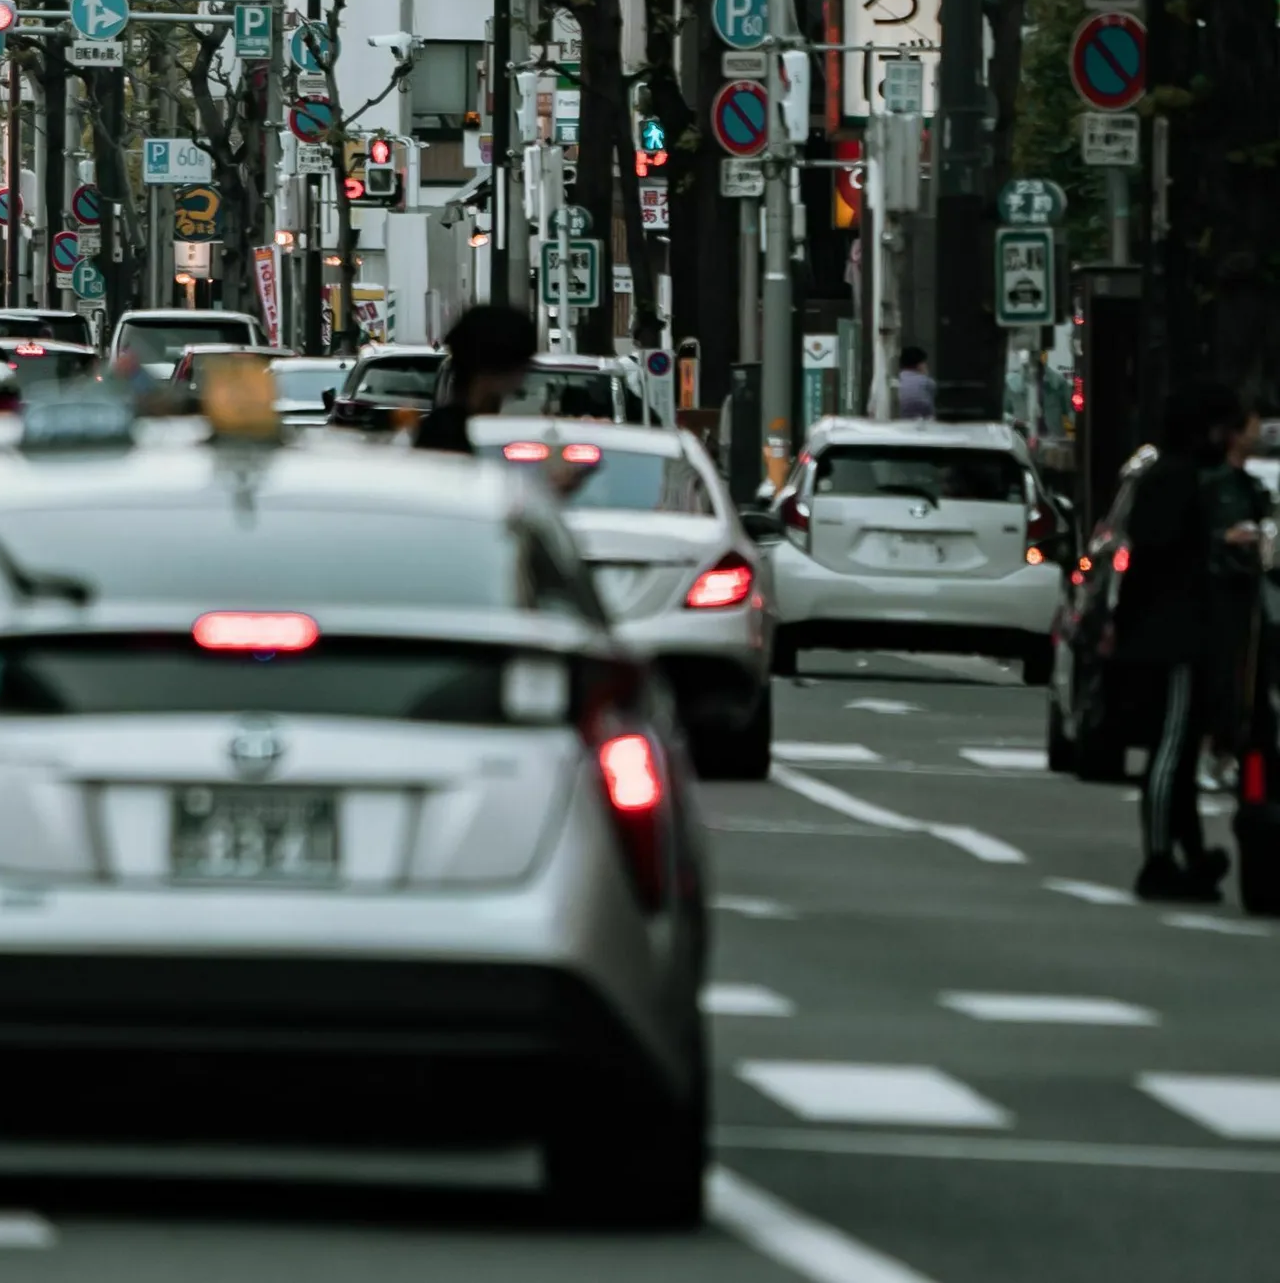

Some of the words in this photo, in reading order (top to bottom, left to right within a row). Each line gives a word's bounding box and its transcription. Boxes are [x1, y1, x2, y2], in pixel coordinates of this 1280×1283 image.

[244, 7, 265, 36] P
[74, 47, 121, 62] 自転車を除く
[152, 143, 166, 162] P
[79, 267, 97, 293] P
